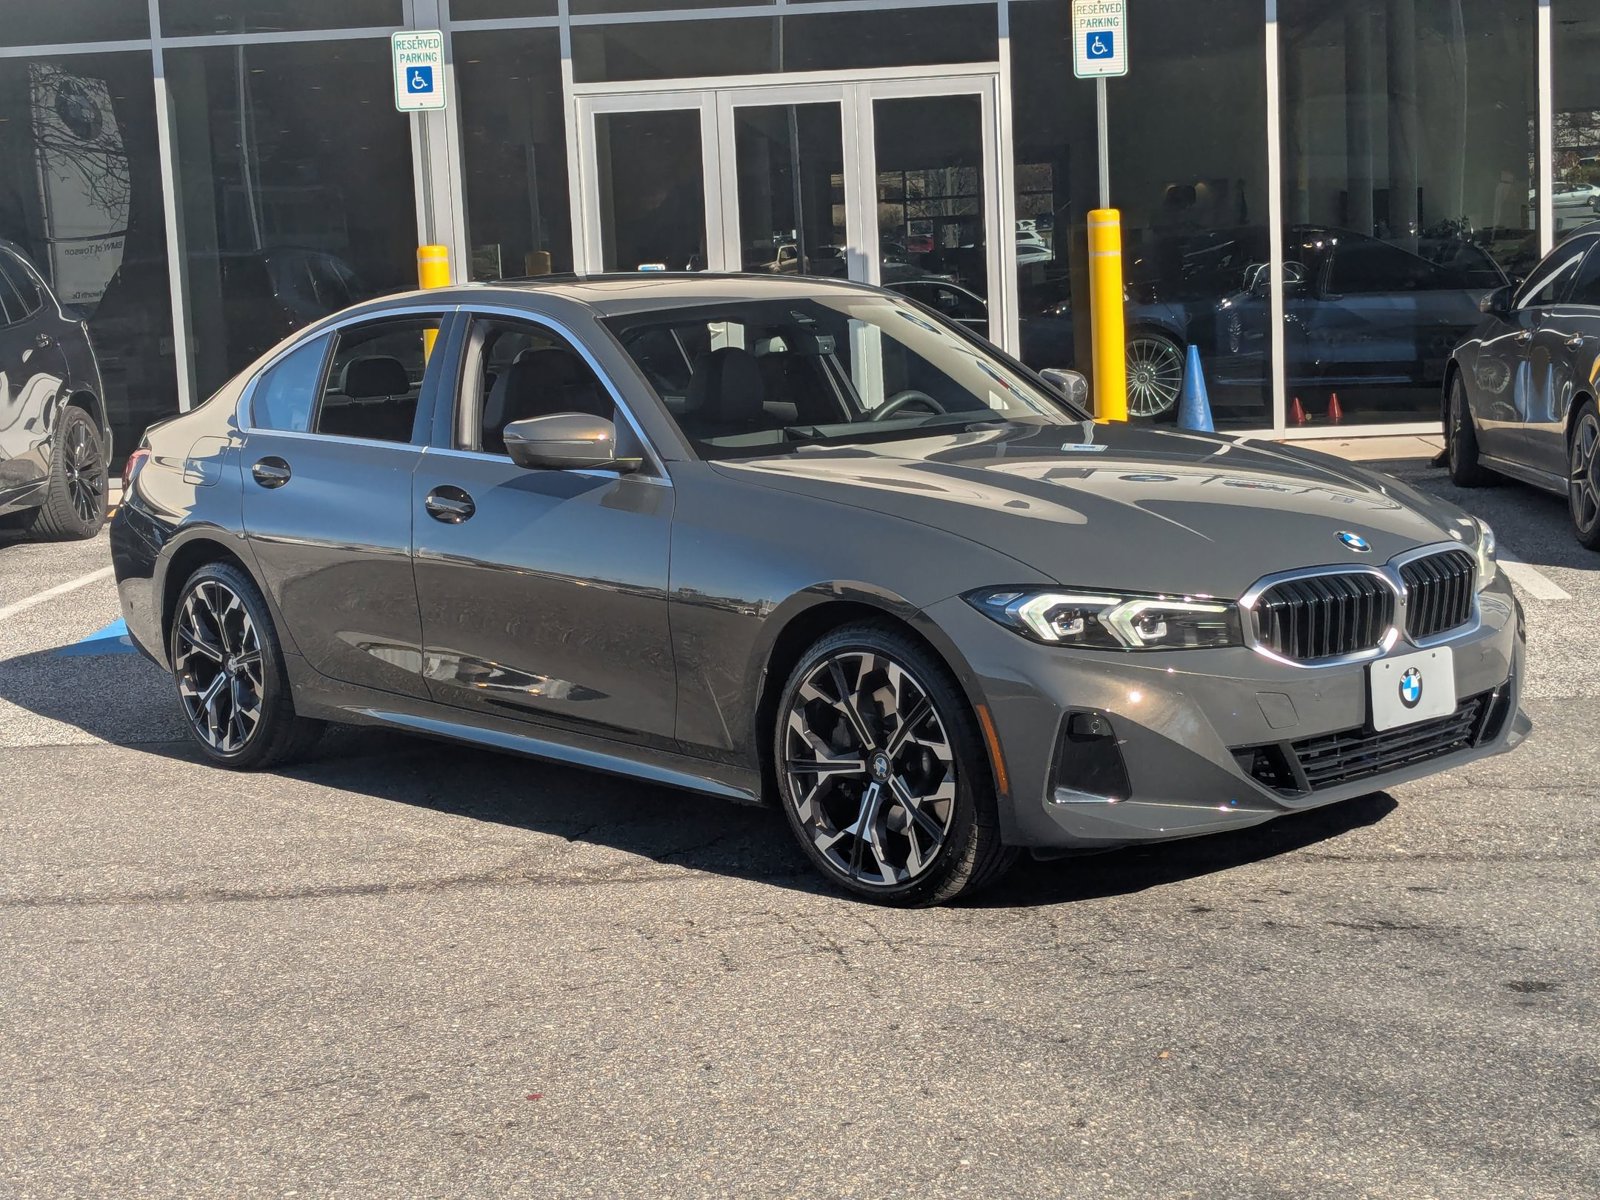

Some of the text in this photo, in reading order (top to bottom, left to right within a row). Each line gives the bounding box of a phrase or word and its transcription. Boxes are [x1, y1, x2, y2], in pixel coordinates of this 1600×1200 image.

[1076, 3, 1121, 15] RESERVED
[1080, 17, 1119, 28] PARKING
[395, 39, 439, 50] RESERVED
[400, 52, 437, 63] PARKING
